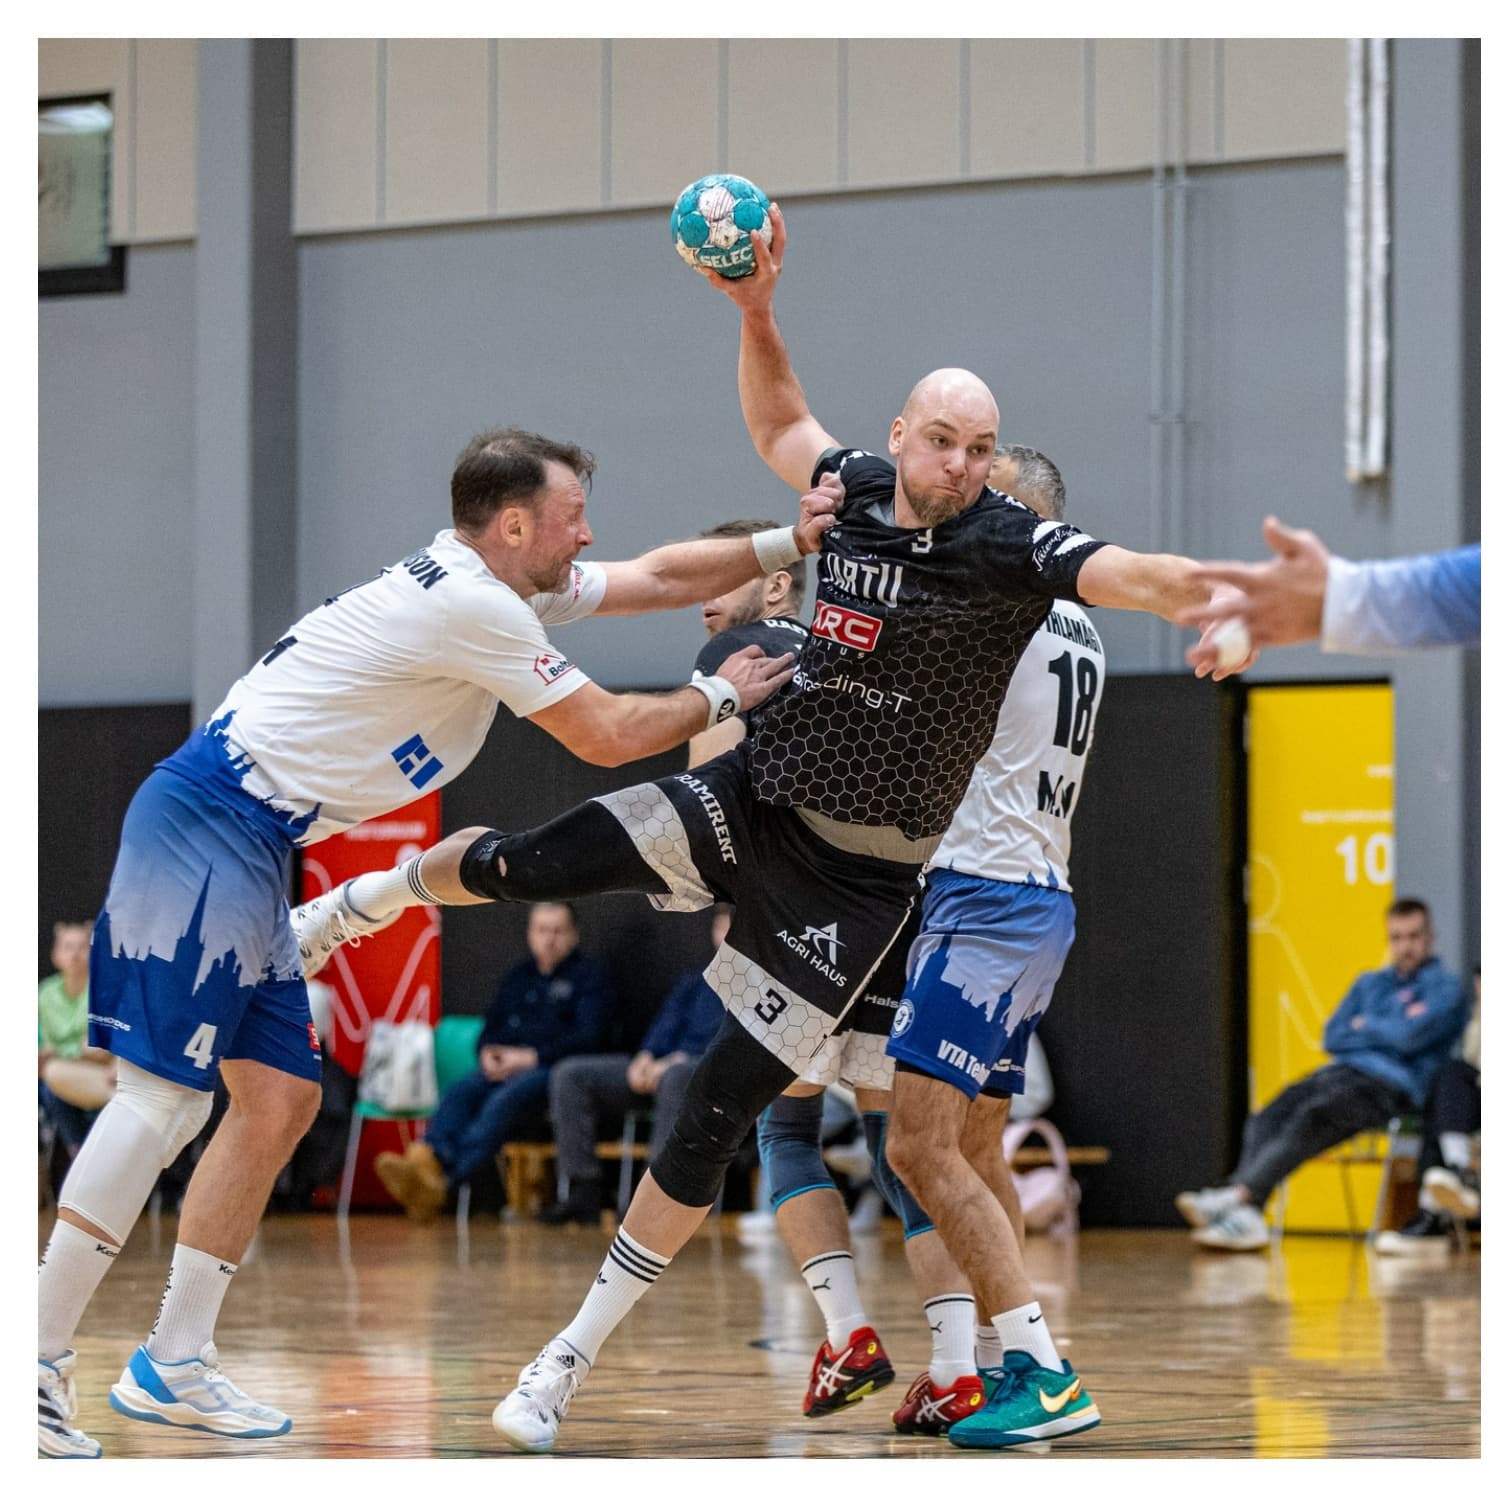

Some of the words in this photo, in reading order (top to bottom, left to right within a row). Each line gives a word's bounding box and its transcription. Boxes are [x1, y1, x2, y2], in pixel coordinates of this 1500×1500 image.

[700, 246, 753, 268] SELEC
[1048, 650, 1098, 757] 18
[674, 773, 738, 864] RAMIRENT
[776, 929, 814, 961] AGRI
[810, 955, 849, 989] HAUS
[754, 988, 788, 1025] 3
[183, 1022, 217, 1070] 4
[937, 1039, 968, 1069] VTA
